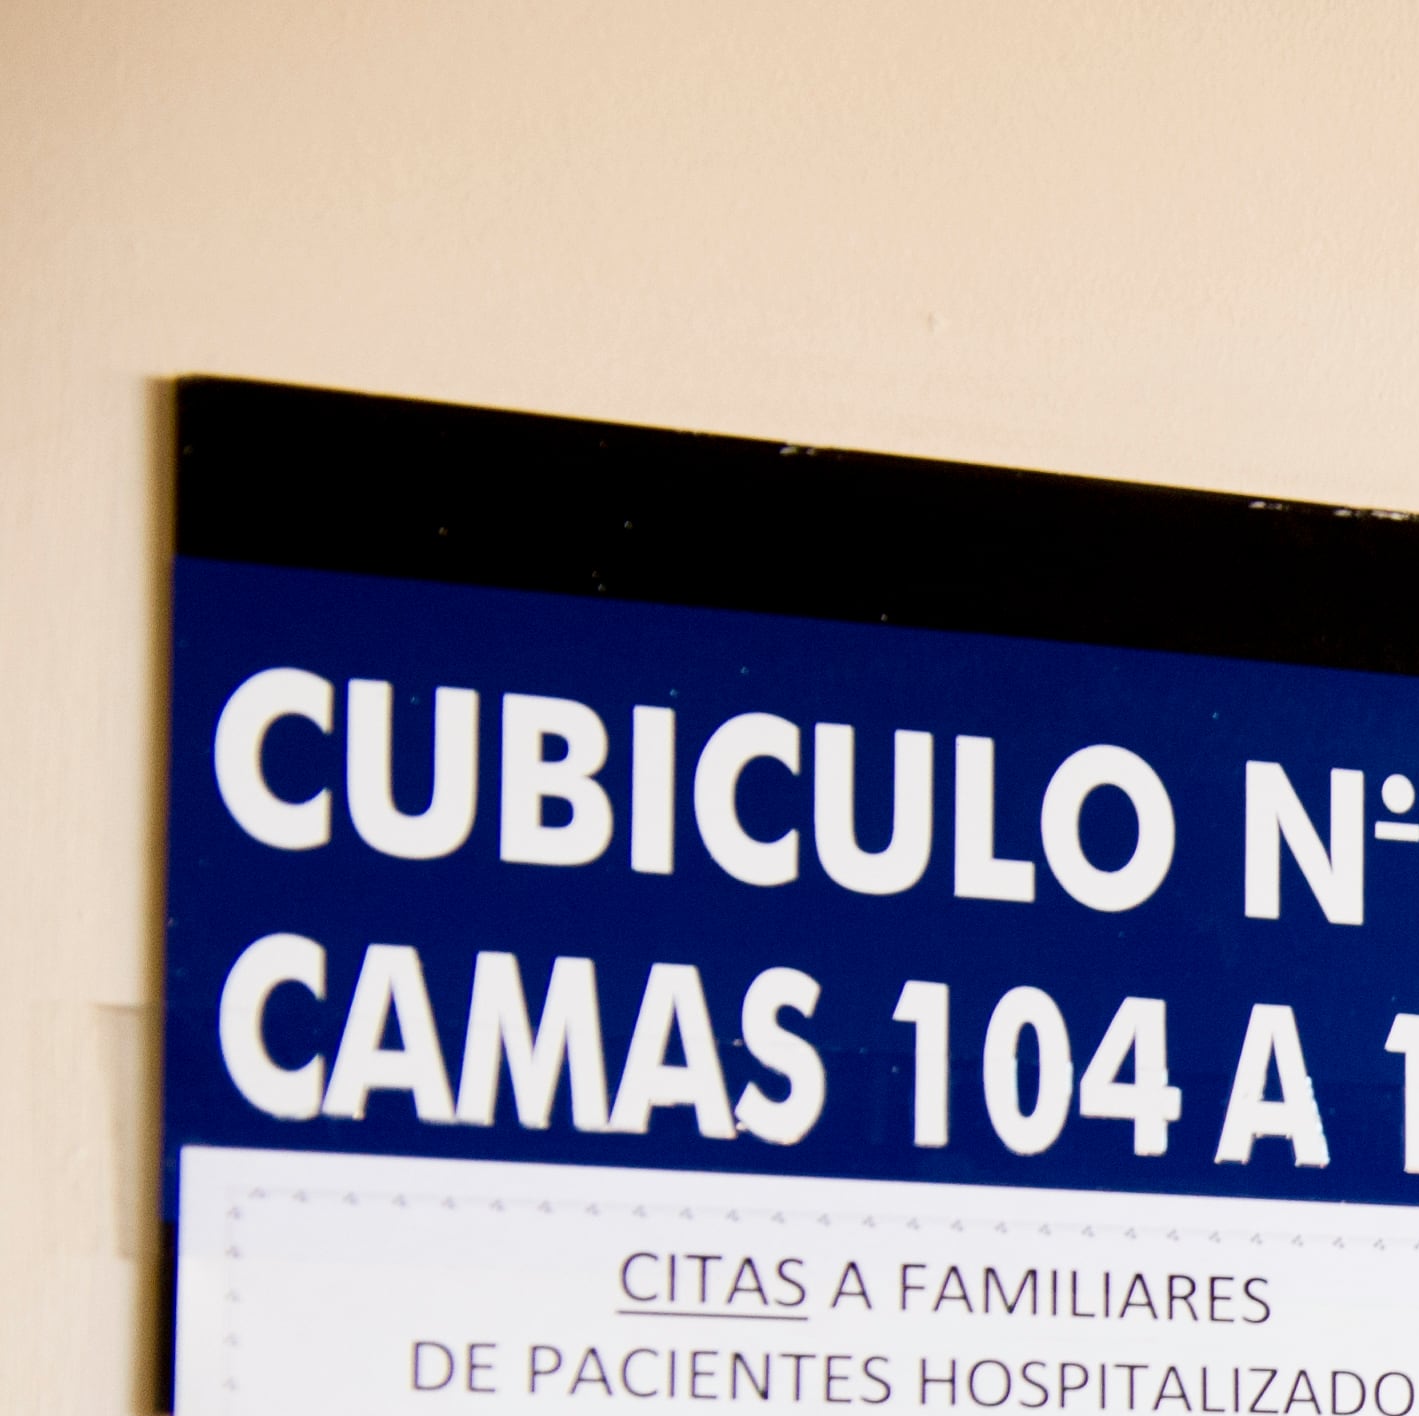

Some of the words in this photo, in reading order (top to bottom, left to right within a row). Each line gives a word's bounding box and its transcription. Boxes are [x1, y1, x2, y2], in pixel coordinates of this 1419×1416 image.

[214, 667, 1176, 913] CUBICULO
[218, 932, 827, 1146] CAMAS
[892, 979, 1183, 1157] 104
[1213, 1002, 1331, 1169] A
[620, 1251, 807, 1308] CITAS
[830, 1260, 873, 1310] A
[900, 1262, 1271, 1325] FAMILIARES
[411, 1340, 497, 1394] DE
[528, 1344, 892, 1405] PACIENTES
